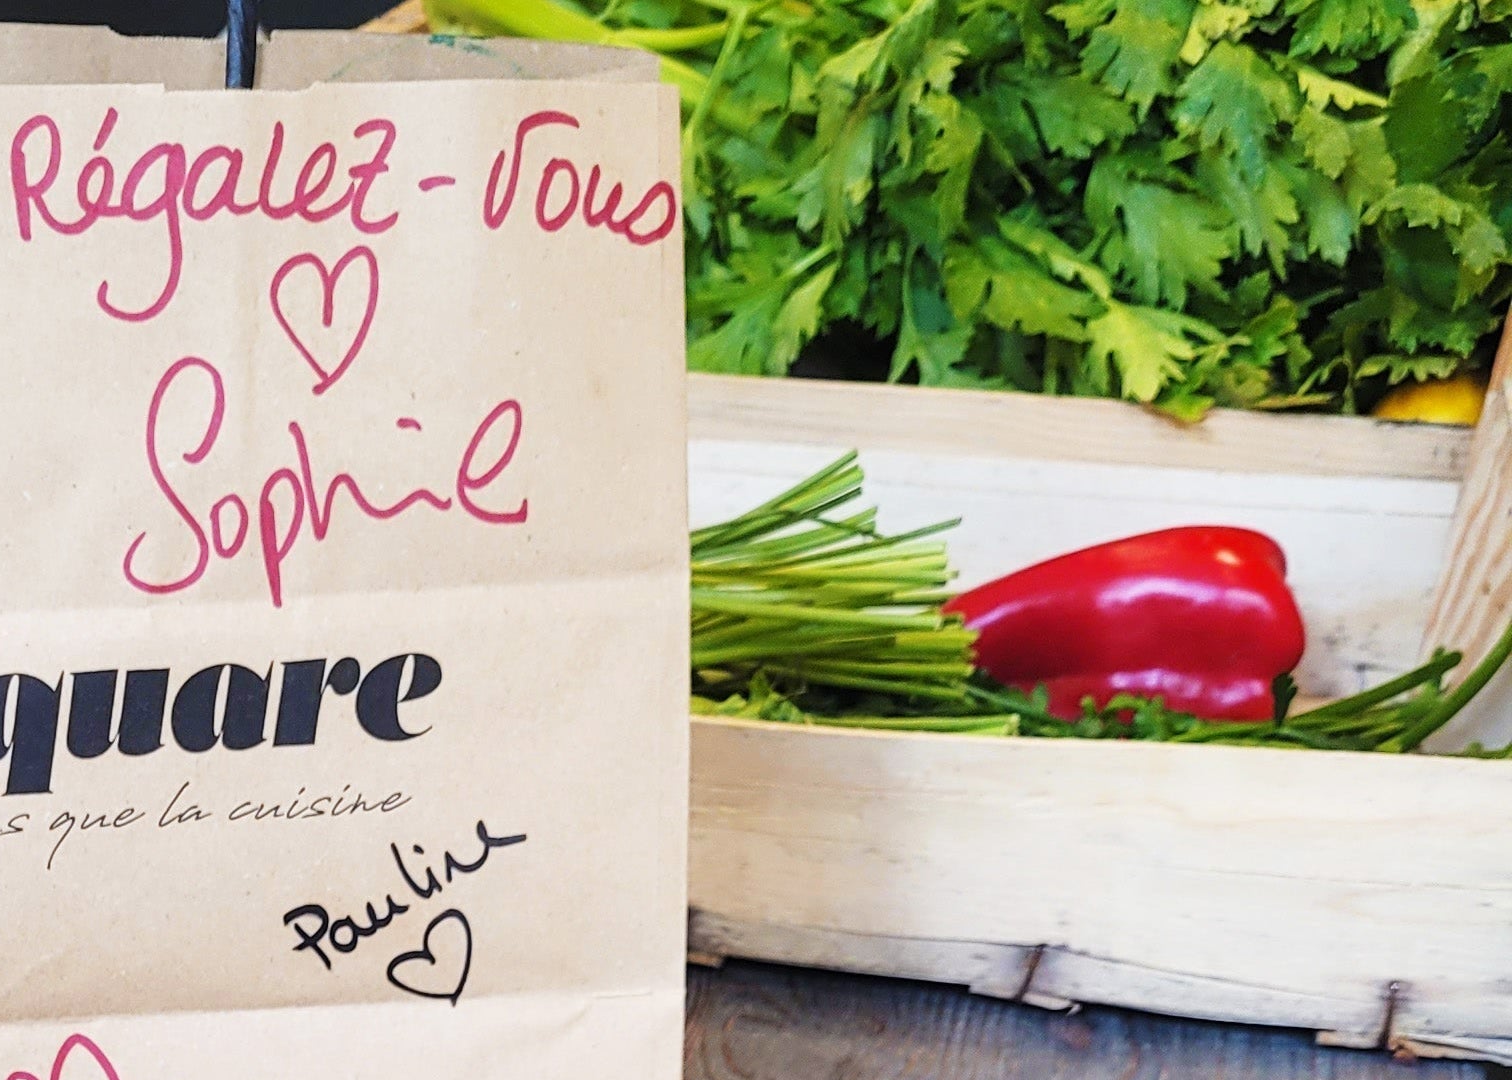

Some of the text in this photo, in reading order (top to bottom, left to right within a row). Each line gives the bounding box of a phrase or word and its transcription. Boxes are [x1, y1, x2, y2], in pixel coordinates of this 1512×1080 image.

[123, 356, 528, 607] Sophie
[47, 806, 147, 871] que
[157, 781, 213, 828] la
[227, 783, 413, 821] cuisine
[283, 820, 527, 970] Pauline
